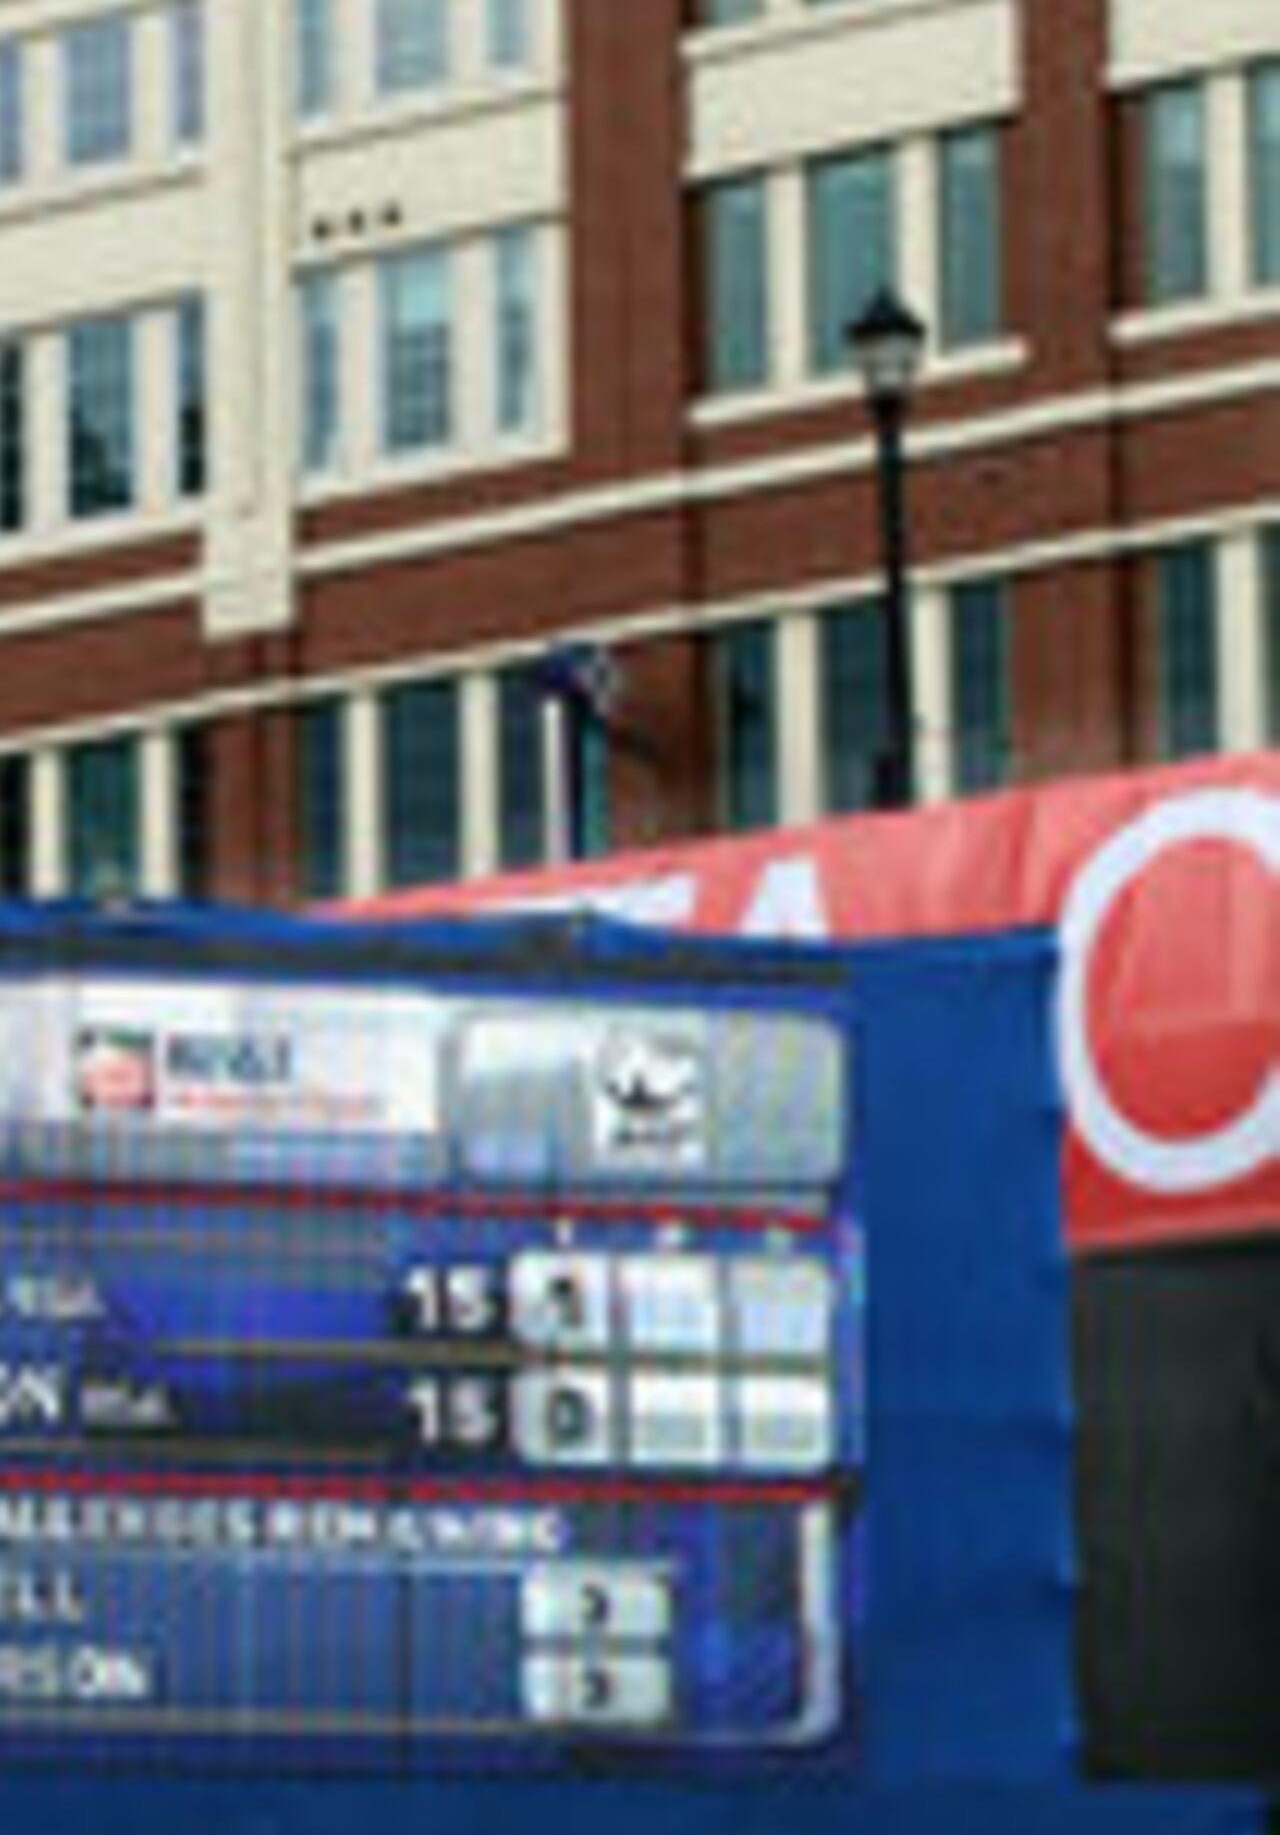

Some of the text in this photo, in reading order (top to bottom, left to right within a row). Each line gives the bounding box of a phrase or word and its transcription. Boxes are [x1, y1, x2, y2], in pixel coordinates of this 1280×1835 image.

[407, 1266, 494, 1331] 15
[407, 1378, 495, 1445] 15
[547, 1386, 591, 1446] 0
